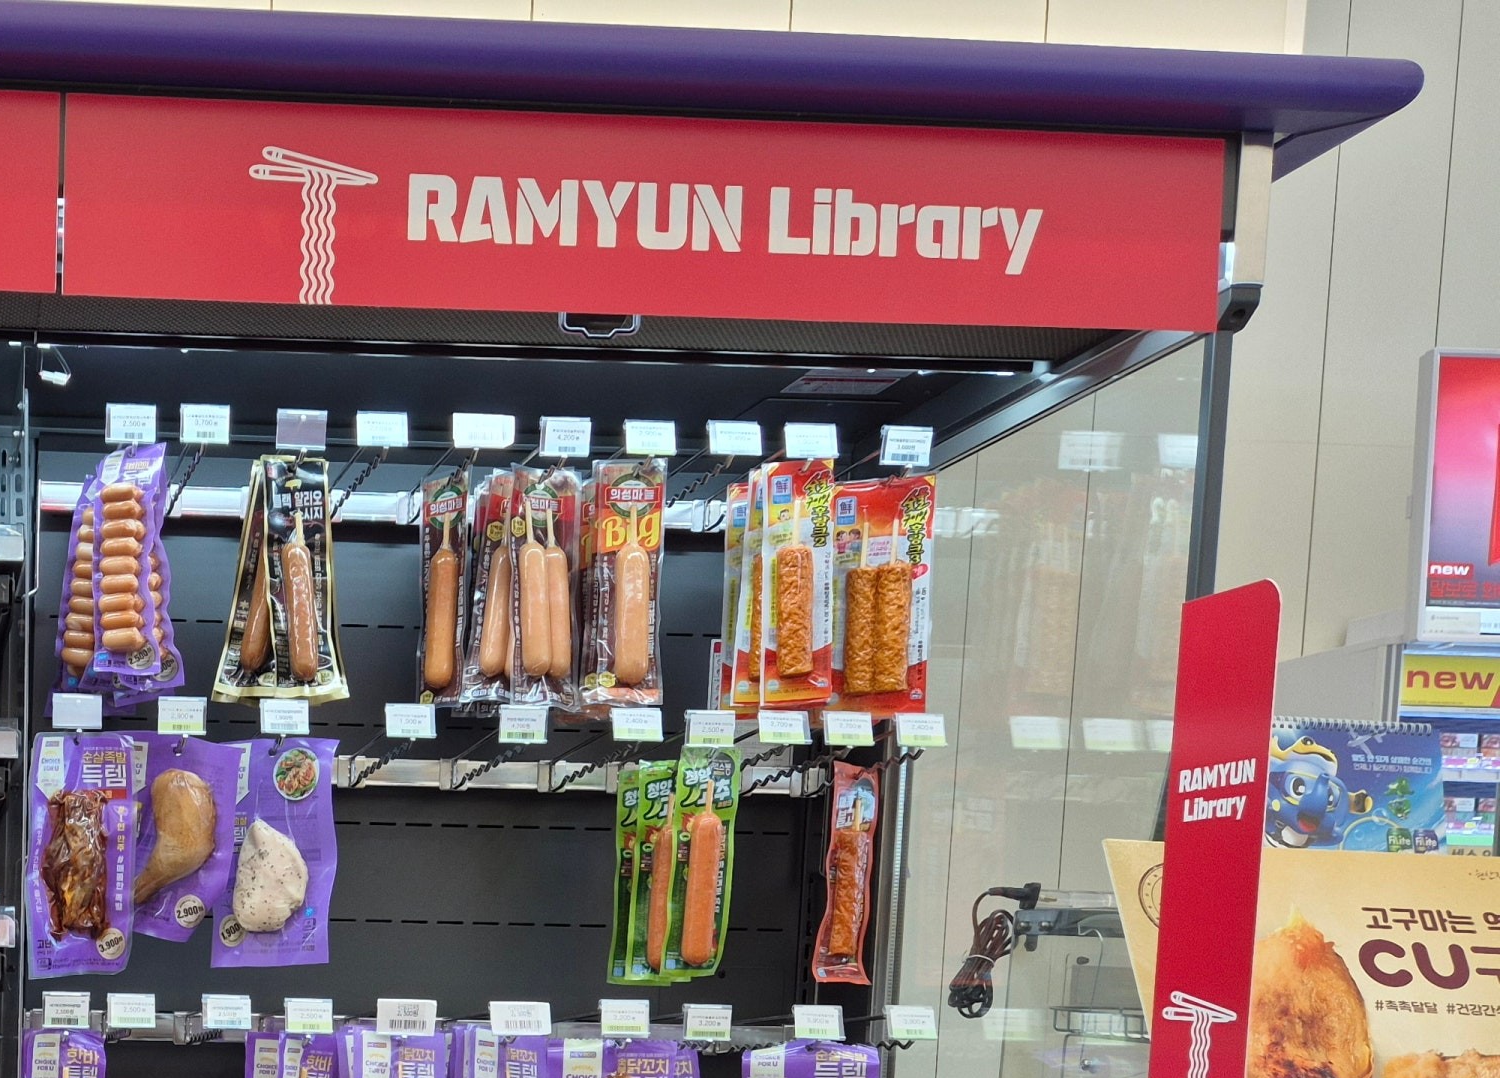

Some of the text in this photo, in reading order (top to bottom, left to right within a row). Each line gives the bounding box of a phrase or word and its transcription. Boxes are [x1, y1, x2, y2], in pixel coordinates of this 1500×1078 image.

[407, 172, 1042, 274] RAMYUN Library
[602, 511, 661, 549] Big
[1430, 564, 1470, 576] new
[1406, 669, 1495, 691] new
[82, 764, 127, 788] 득템
[1179, 758, 1256, 794] RAMYUN
[1183, 793, 1247, 823] Library
[1361, 906, 1477, 935] 고구마는
[1374, 999, 1439, 1015] #촉촉달달
[66, 1048, 100, 1065] 핫바
